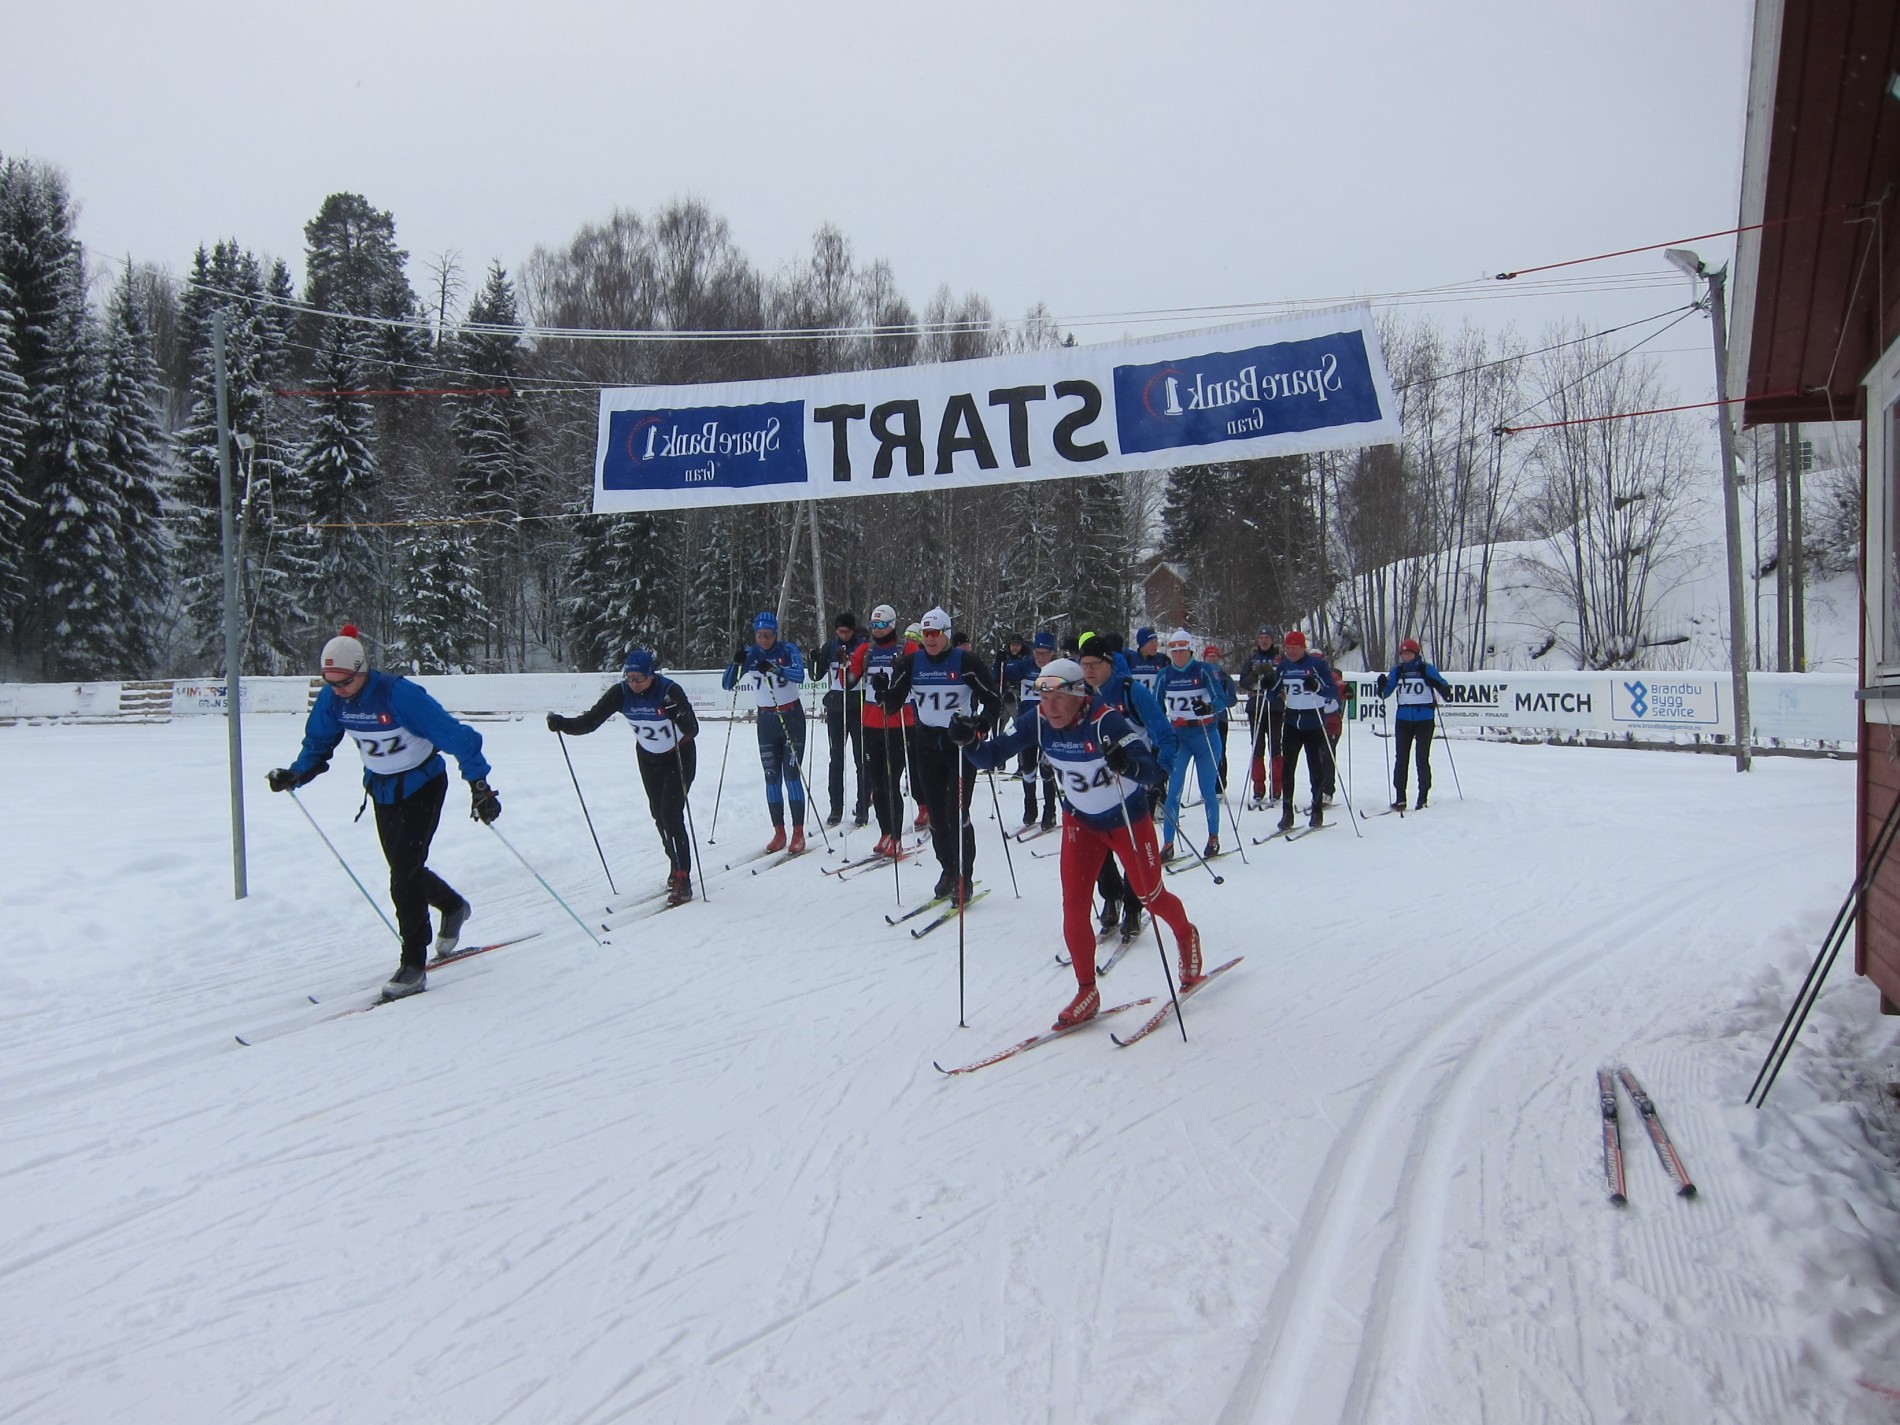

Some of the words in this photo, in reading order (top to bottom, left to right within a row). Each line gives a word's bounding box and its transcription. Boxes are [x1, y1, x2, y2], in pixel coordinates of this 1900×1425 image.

[919, 670, 947, 678] SpareBank
[1284, 684, 1312, 695] 73
[1397, 682, 1424, 695] 770
[1447, 684, 1491, 703] GRAN
[1651, 683, 1702, 695] Brandbu
[914, 691, 959, 711] 712
[1515, 692, 1592, 713] MATCH
[1651, 695, 1683, 708] Bygg
[342, 711, 378, 720] SpareBank
[380, 714, 387, 723] 1
[1360, 699, 1387, 722] pris
